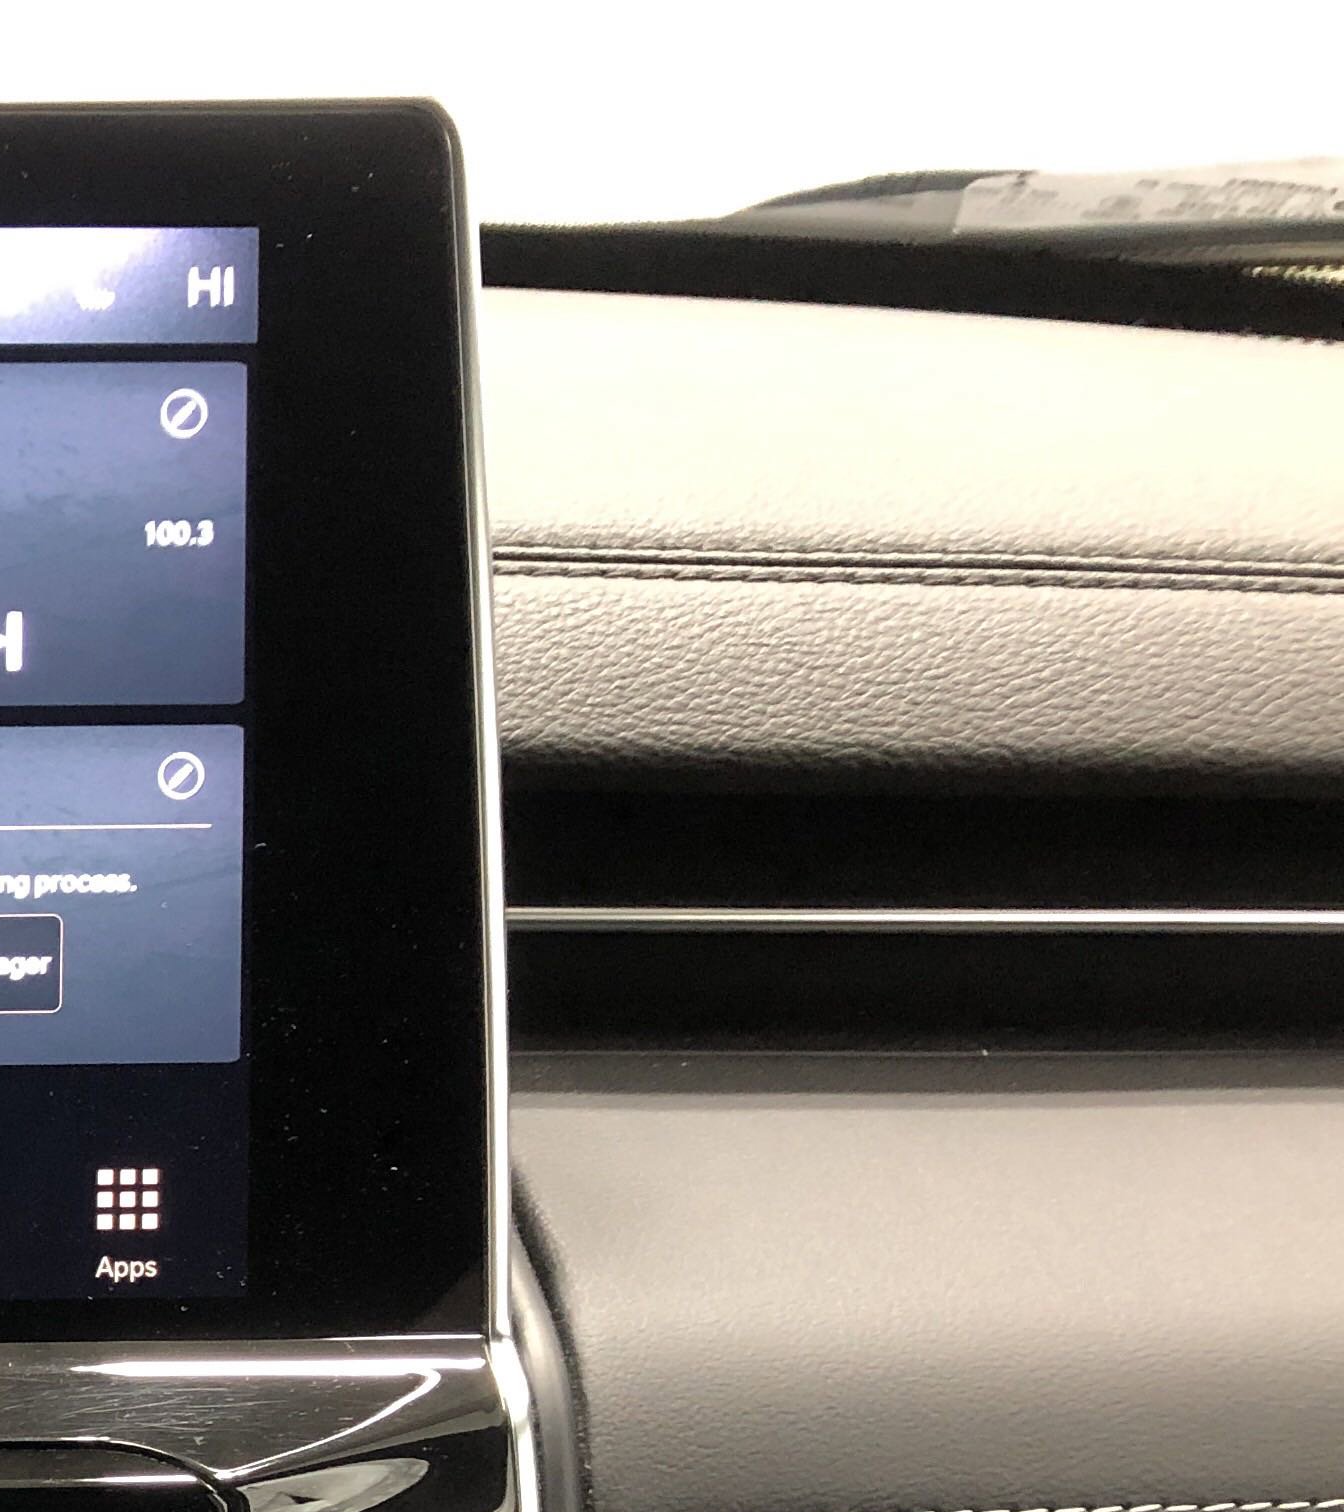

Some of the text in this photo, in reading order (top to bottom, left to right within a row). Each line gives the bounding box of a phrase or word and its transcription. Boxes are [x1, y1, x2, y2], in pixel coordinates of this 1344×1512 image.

[187, 266, 235, 308] HI
[145, 520, 214, 547] 100.3
[96, 1256, 157, 1282] Apps
